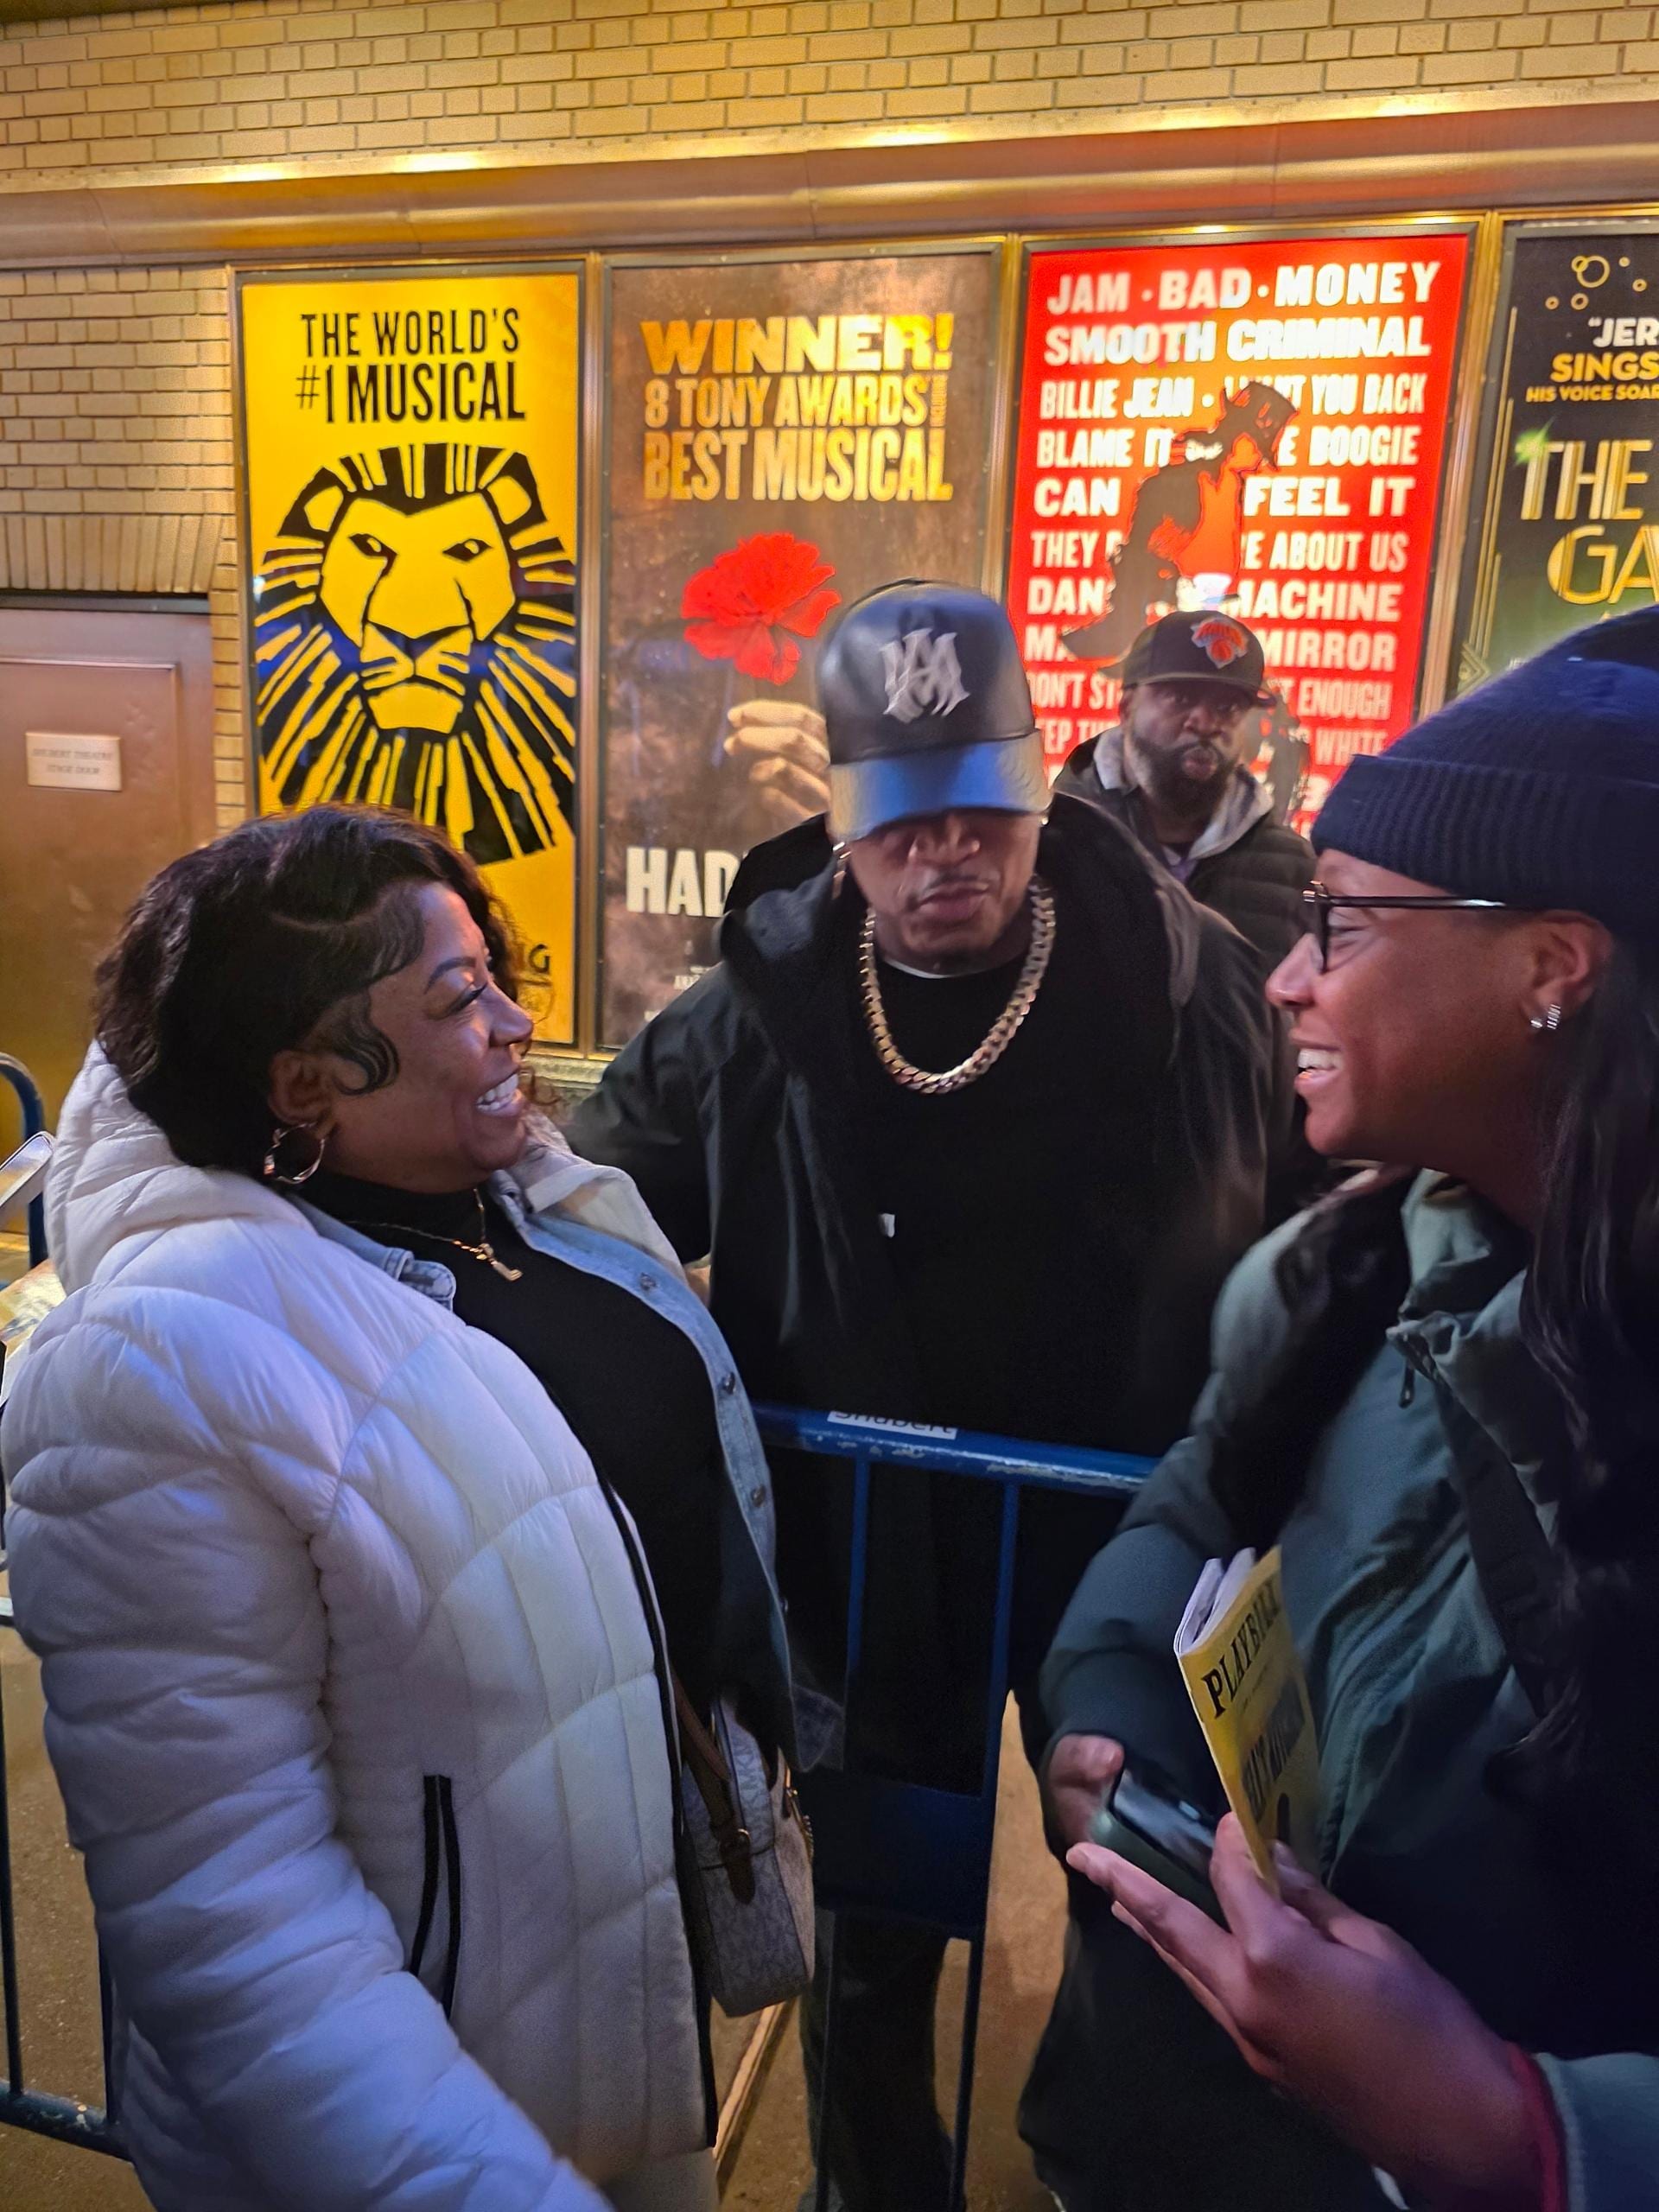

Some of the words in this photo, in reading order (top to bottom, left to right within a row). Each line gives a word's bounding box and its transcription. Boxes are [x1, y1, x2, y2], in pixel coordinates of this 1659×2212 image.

[1046, 270, 1130, 315] JAM
[1159, 267, 1252, 311] BAD
[1274, 261, 1440, 308] MONEY
[300, 313, 359, 357] THE
[374, 307, 520, 355] WORLD'S
[640, 312, 955, 374] WINNER!
[1044, 320, 1217, 366] SMOOTH
[1225, 315, 1432, 362] CRIMINAL
[1549, 351, 1659, 383] SINGS
[296, 364, 334, 423] #1
[347, 361, 525, 423] MUSICAL
[645, 378, 670, 429] 8
[675, 375, 772, 429] TONY
[773, 372, 928, 427] AWARDS
[1039, 378, 1121, 420] BILLIE
[1122, 376, 1195, 419] JEAN
[1310, 373, 1359, 416] YOU
[1363, 372, 1428, 415] BACK
[1526, 385, 1556, 403] HIS
[1559, 385, 1613, 402] VOICE
[644, 429, 749, 501] BEST
[753, 426, 954, 502] MUSICAL
[1036, 429, 1135, 468] BLAME
[1309, 424, 1421, 467] BOOGIE
[1033, 477, 1122, 518] CAN
[1243, 476, 1351, 517] FEEL
[1369, 476, 1416, 518] IT
[1515, 439, 1653, 520] THE
[1030, 530, 1101, 569] THEY
[1269, 531, 1364, 572] ABOUT
[1369, 531, 1410, 573] US
[1254, 628, 1397, 672] MIRROR
[1296, 677, 1394, 721] ENOUGH
